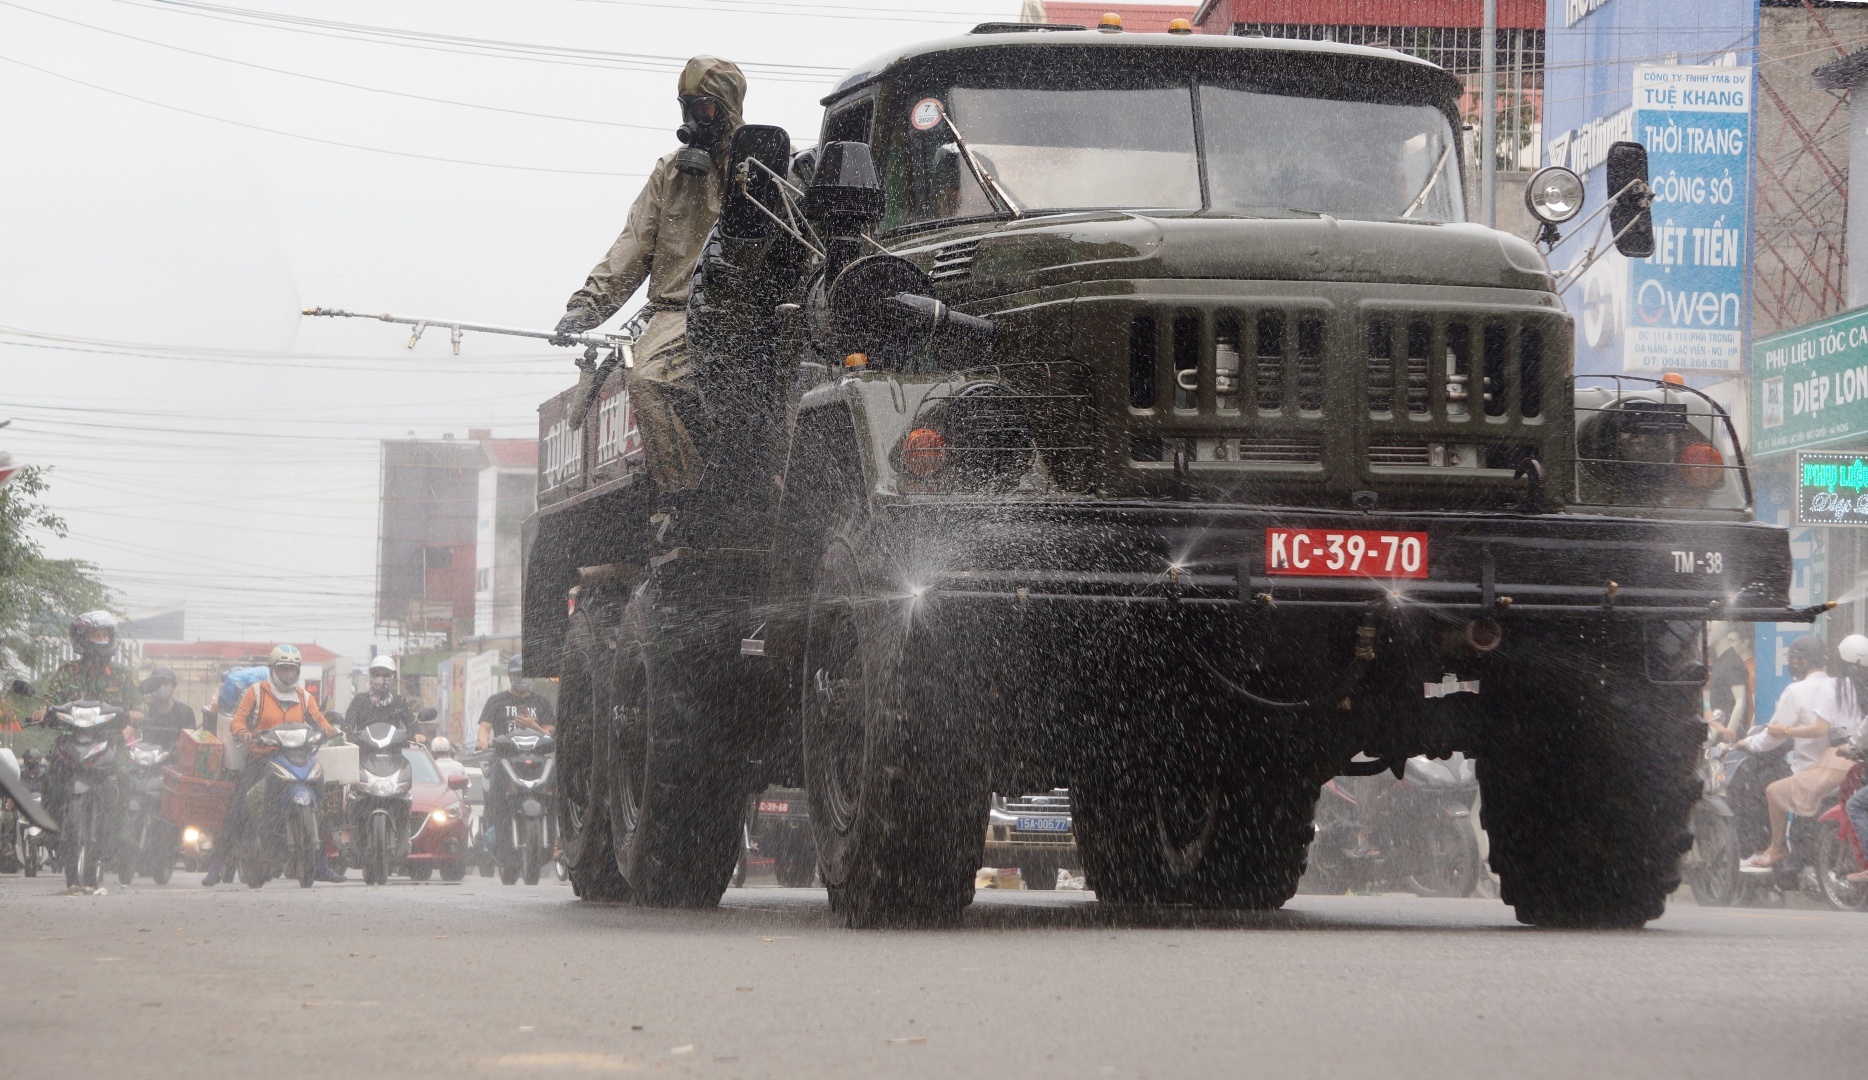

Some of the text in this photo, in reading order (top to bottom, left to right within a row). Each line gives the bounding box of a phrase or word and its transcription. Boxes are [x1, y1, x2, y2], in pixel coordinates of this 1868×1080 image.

[1644, 85, 1744, 108] TUỆ KHANG
[1671, 73, 1682, 81] TY
[1685, 74, 1708, 82] TNHH
[1645, 118, 1743, 155] THỜI TRANG
[1652, 167, 1734, 204] CÔNG SỞ
[1693, 214, 1739, 267] TIẾN
[1638, 279, 1740, 327] Owen
[1728, 348, 1738, 356] HP
[1765, 347, 1788, 372] PHỤ
[1791, 338, 1816, 367] LIỆU
[1819, 328, 1846, 356] TÓC
[1793, 370, 1830, 418] DIỆP
[1271, 533, 1421, 572] KC-39-70
